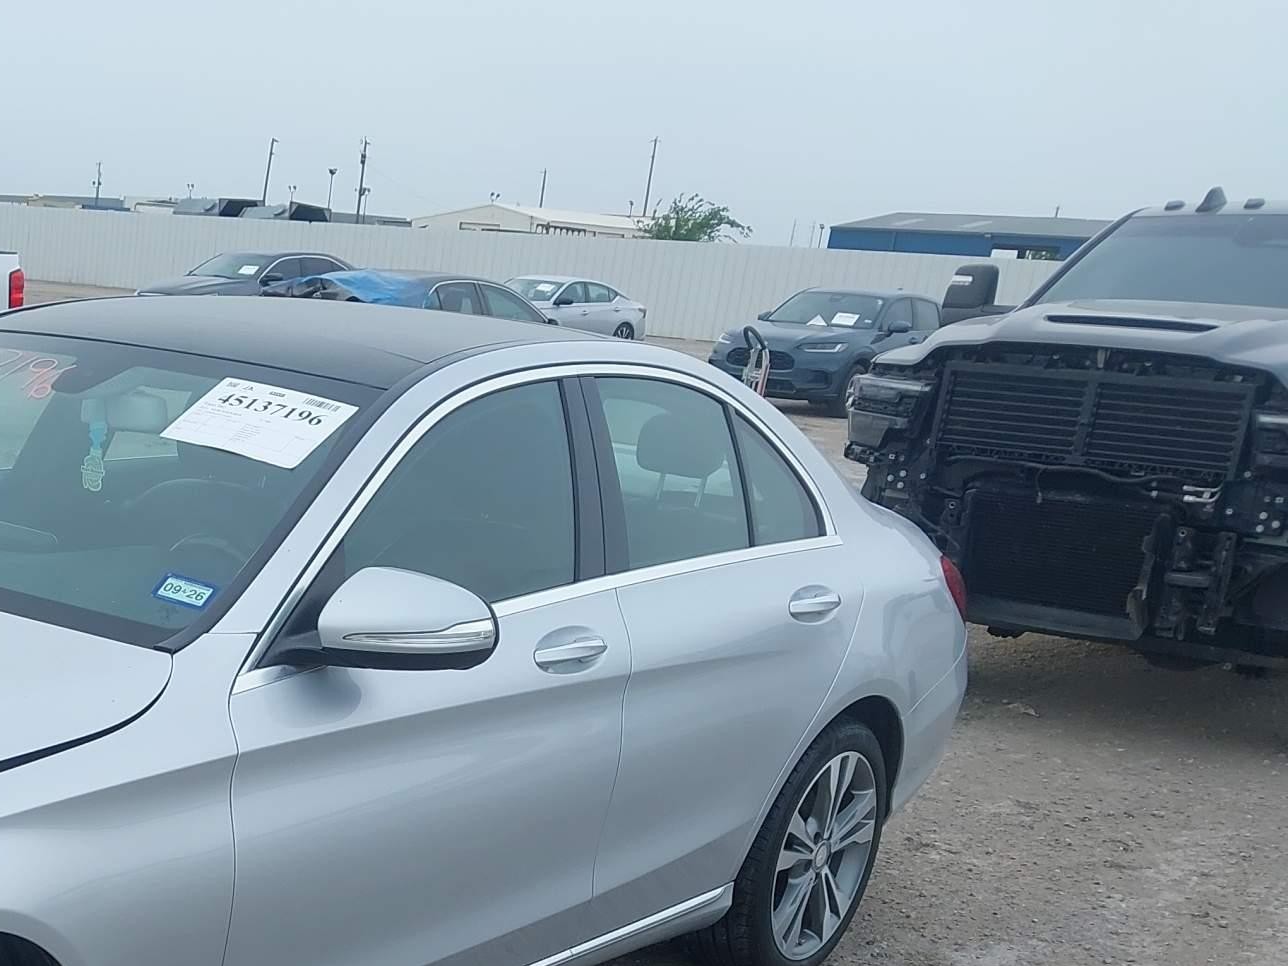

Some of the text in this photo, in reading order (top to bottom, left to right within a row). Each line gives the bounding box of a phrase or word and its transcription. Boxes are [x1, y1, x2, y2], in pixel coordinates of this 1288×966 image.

[218, 393, 328, 426] 45137196
[163, 582, 207, 601] 09 26
